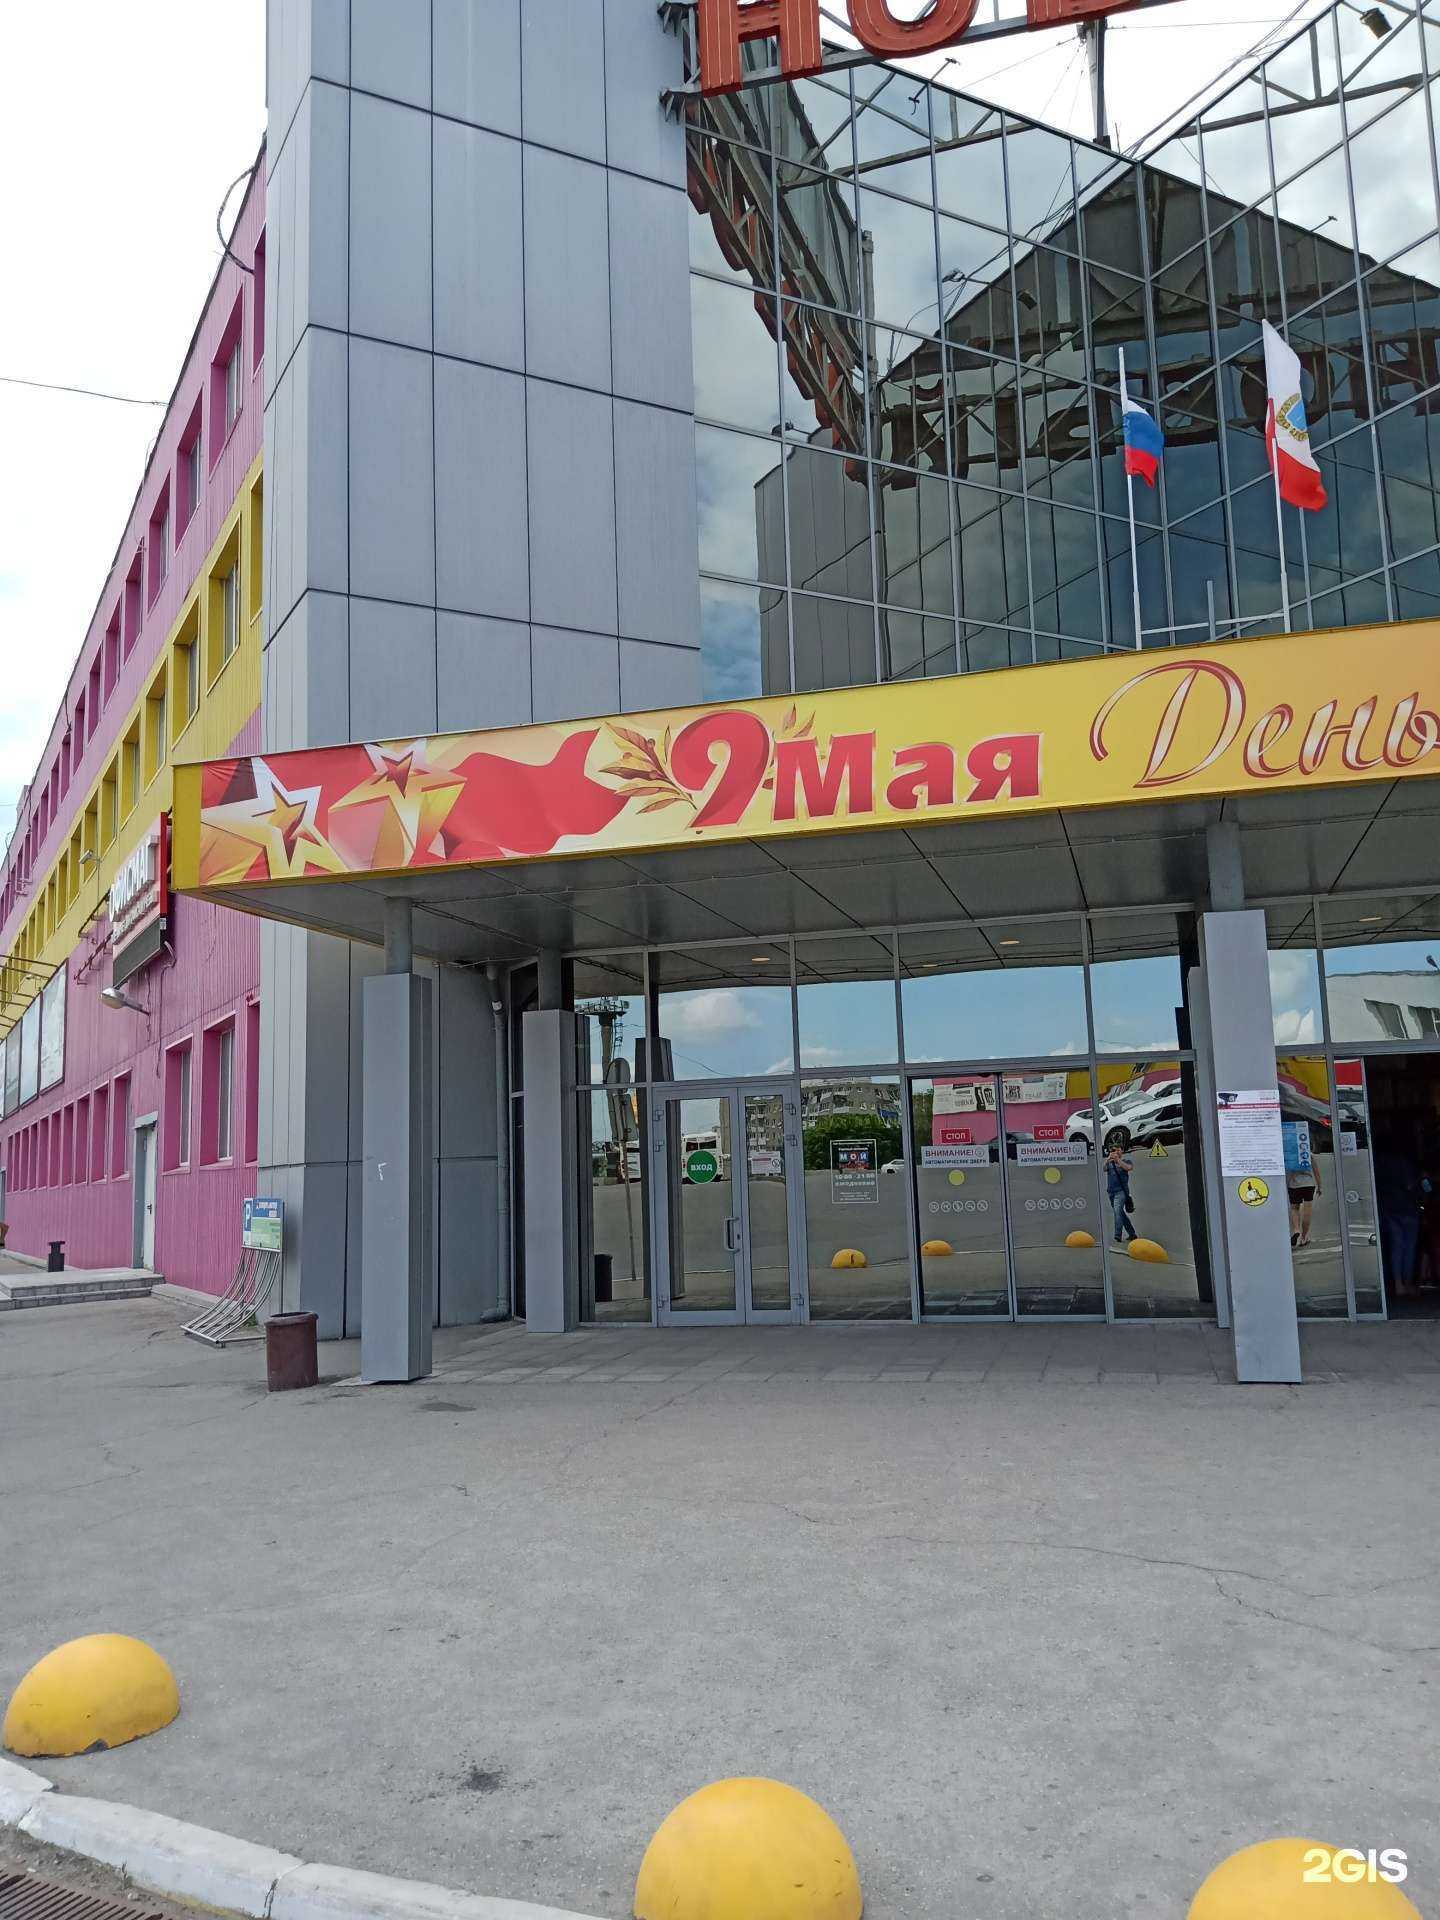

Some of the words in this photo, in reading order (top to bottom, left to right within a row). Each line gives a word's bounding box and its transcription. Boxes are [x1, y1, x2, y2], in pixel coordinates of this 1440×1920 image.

[671, 709, 770, 829] 9
[772, 730, 1042, 822] Мая
[1090, 659, 1440, 788] День
[945, 1132, 966, 1140] СТОП
[1038, 1129, 1059, 1137] СТОП
[925, 1149, 975, 1157] ВНИМАНИЕ!
[1020, 1146, 1071, 1155] ВНИМАНИЕ!
[690, 1163, 713, 1171] ВХОД
